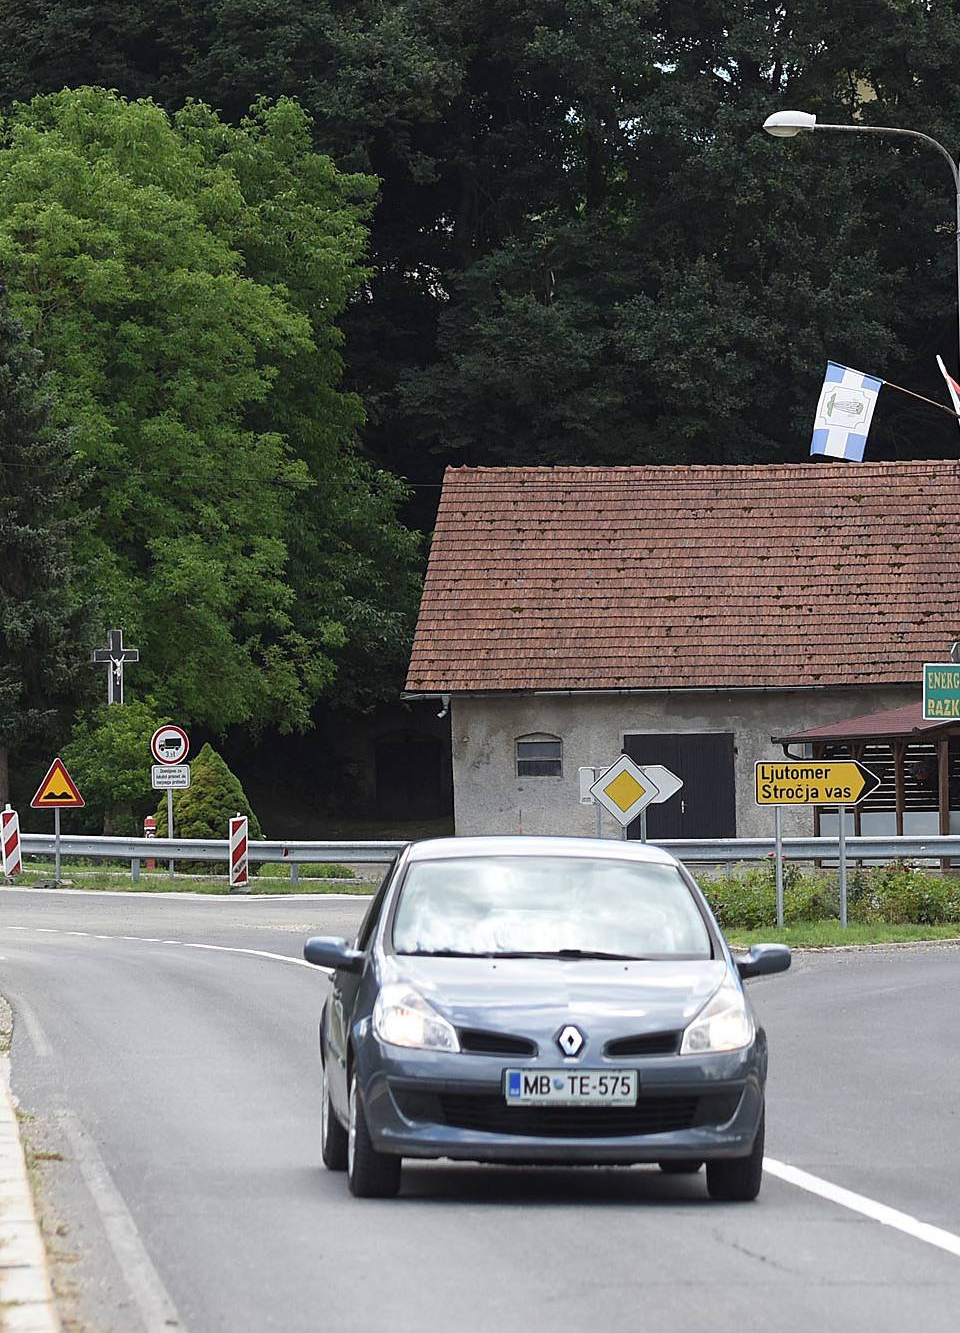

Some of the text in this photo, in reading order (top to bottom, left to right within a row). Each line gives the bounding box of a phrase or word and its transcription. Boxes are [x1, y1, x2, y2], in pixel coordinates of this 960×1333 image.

[761, 765, 831, 783] Ljutomer
[762, 784, 851, 802] Stročja vas
[523, 1075, 551, 1095] MB
[567, 1075, 631, 1096] TE-575
